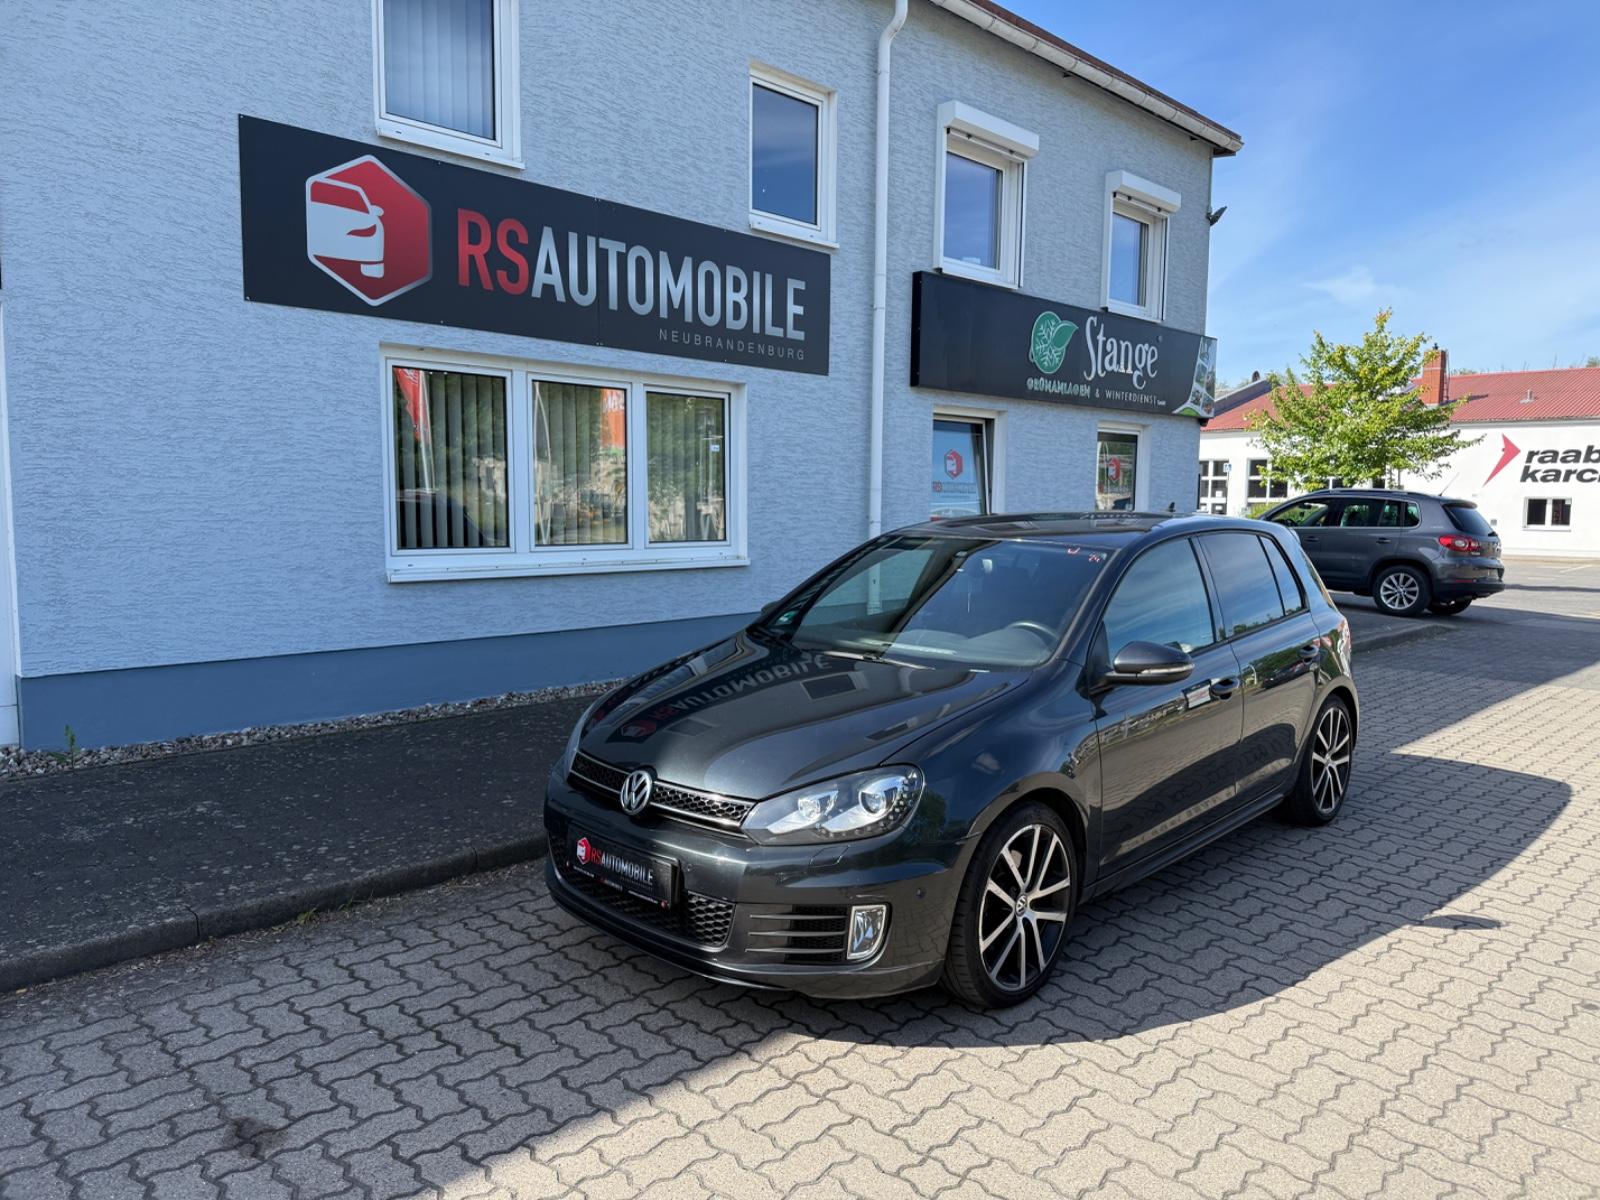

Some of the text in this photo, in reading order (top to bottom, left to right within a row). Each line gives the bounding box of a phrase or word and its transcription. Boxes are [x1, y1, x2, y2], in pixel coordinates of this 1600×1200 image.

[457, 208, 806, 341] RSAUTOMOBILE
[659, 329, 805, 361] NEUBRANDENBURG
[1083, 315, 1158, 390] Stange
[1095, 388, 1100, 398] &
[1105, 389, 1157, 405] WINTERDIENST
[1525, 445, 1600, 464] raab
[1520, 465, 1600, 483] karc
[591, 847, 654, 886] RSAUTOMOBILE
